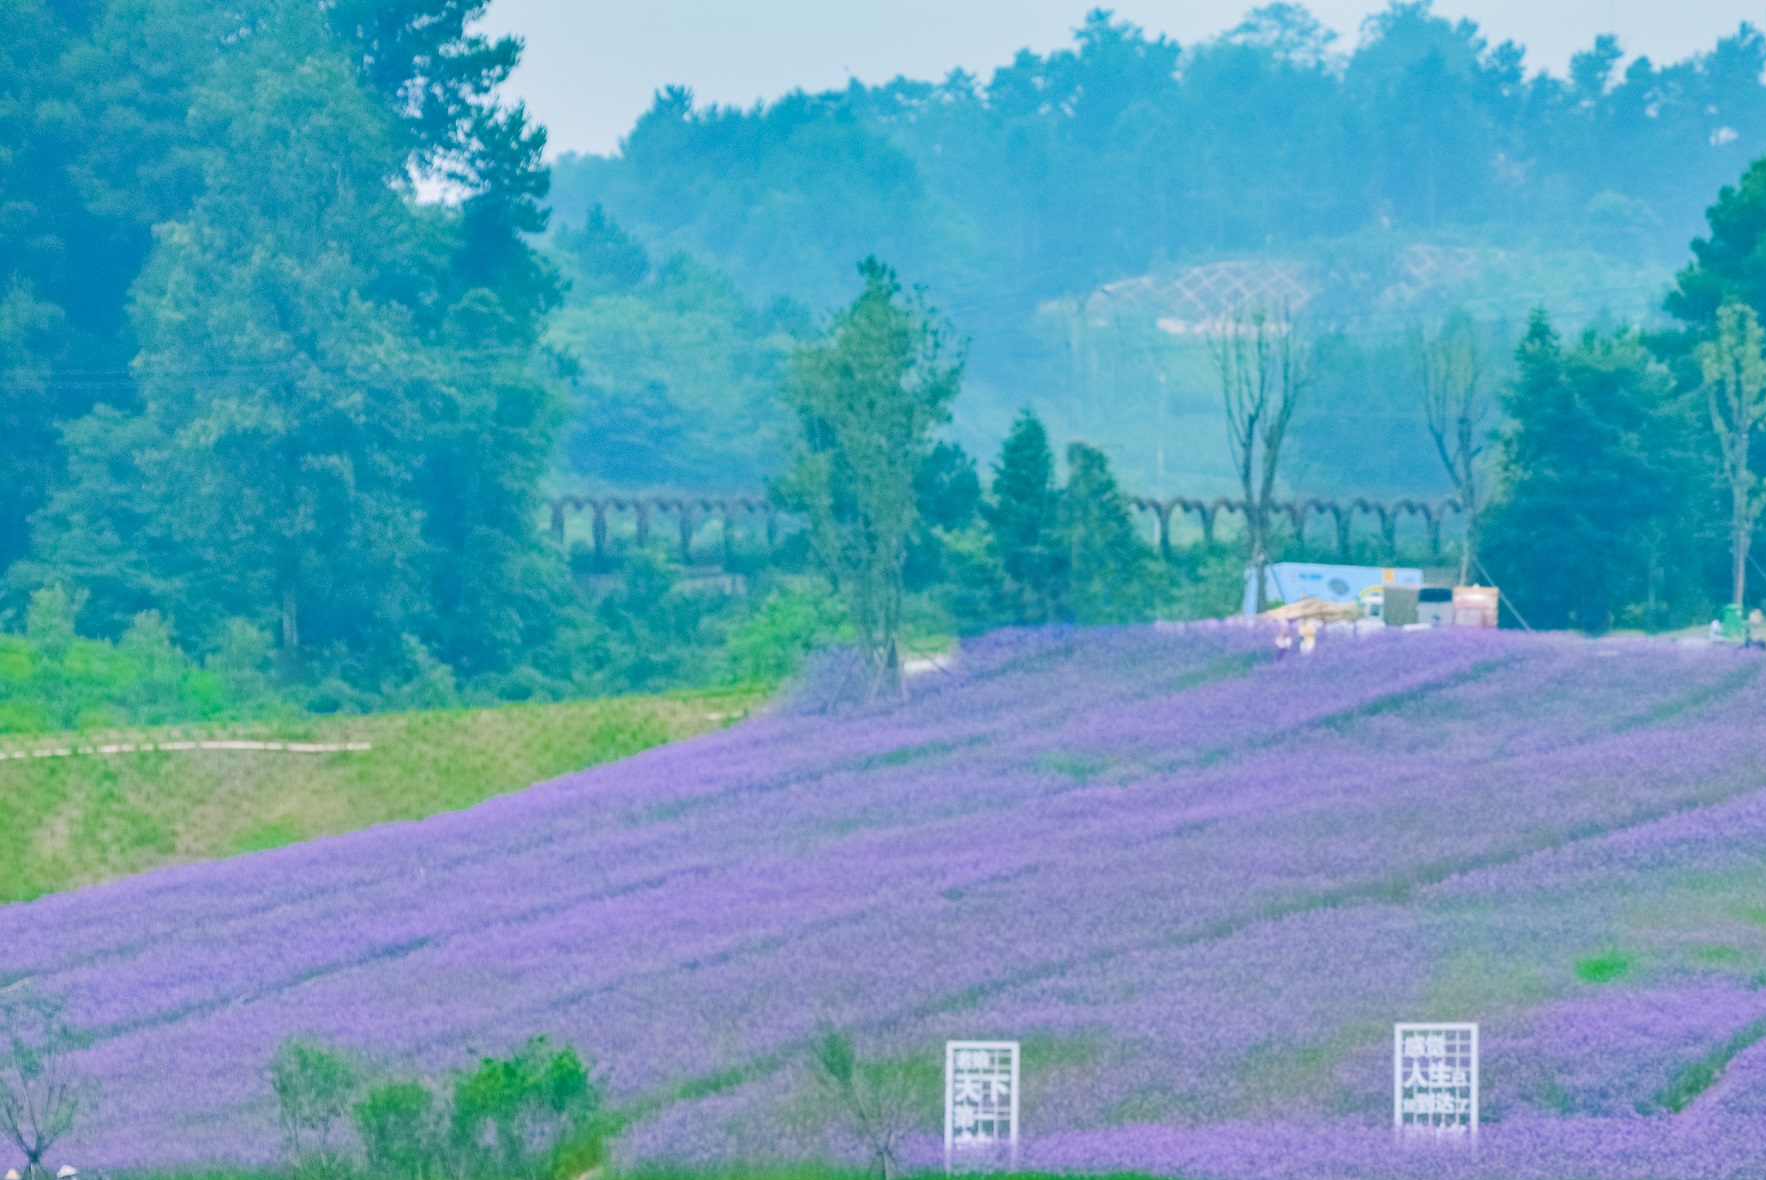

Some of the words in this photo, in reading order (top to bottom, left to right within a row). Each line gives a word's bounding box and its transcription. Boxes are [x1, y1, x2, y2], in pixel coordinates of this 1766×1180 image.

[954, 1072, 1011, 1103] 天下
[1403, 1060, 1467, 1088] 人生已
